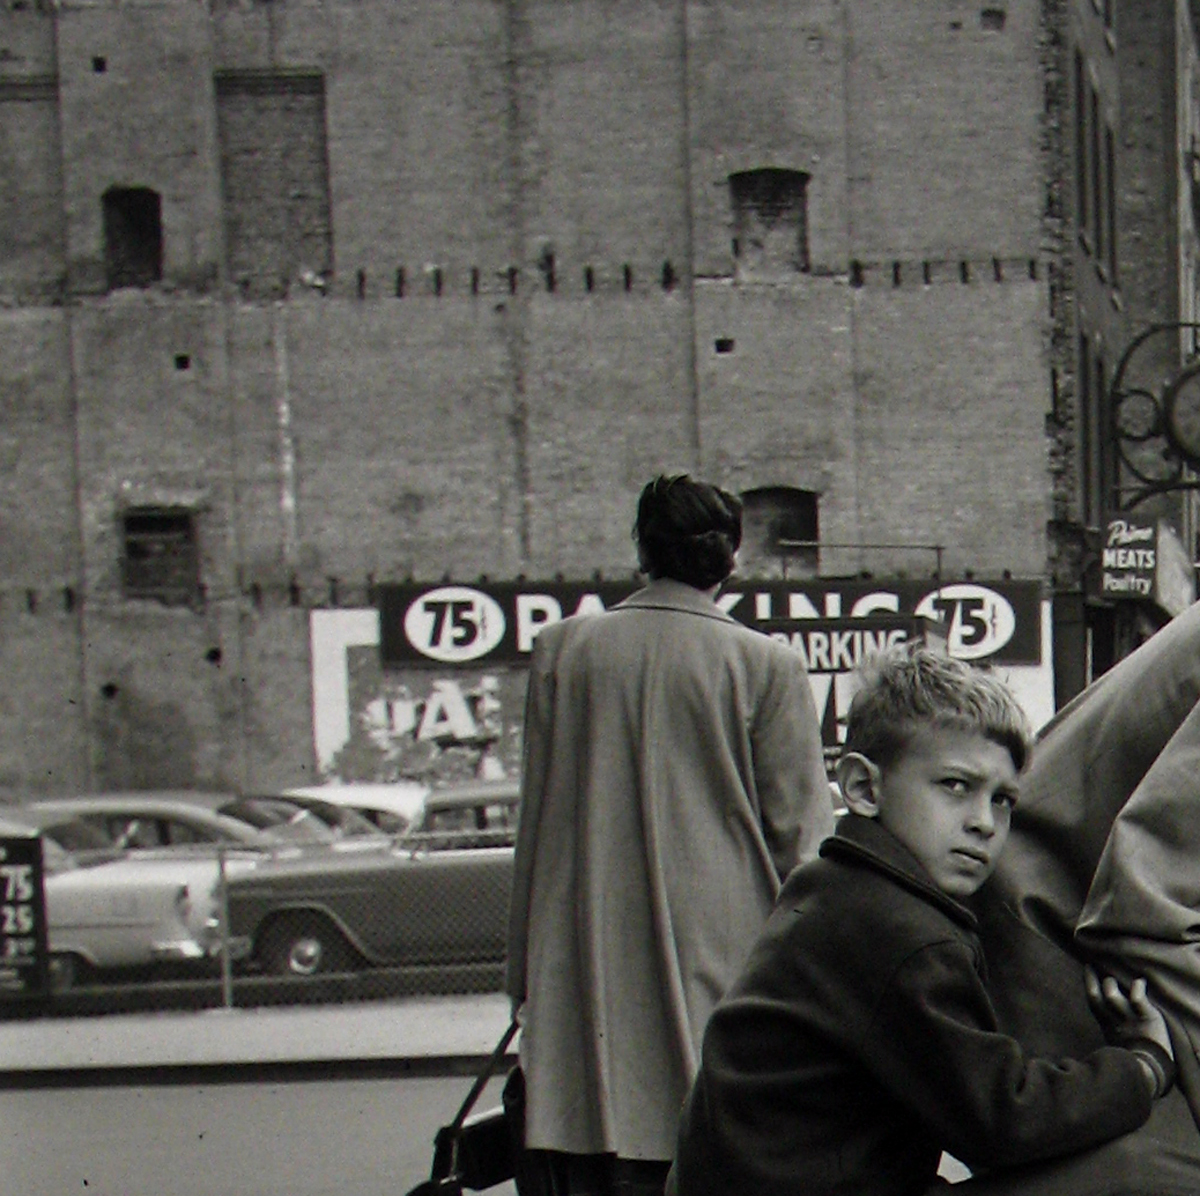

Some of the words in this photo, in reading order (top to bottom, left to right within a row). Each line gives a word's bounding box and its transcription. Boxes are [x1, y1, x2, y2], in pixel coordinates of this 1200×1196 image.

[1102, 548, 1155, 569] MEATS
[423, 600, 479, 647] 75
[933, 597, 988, 646] 75
